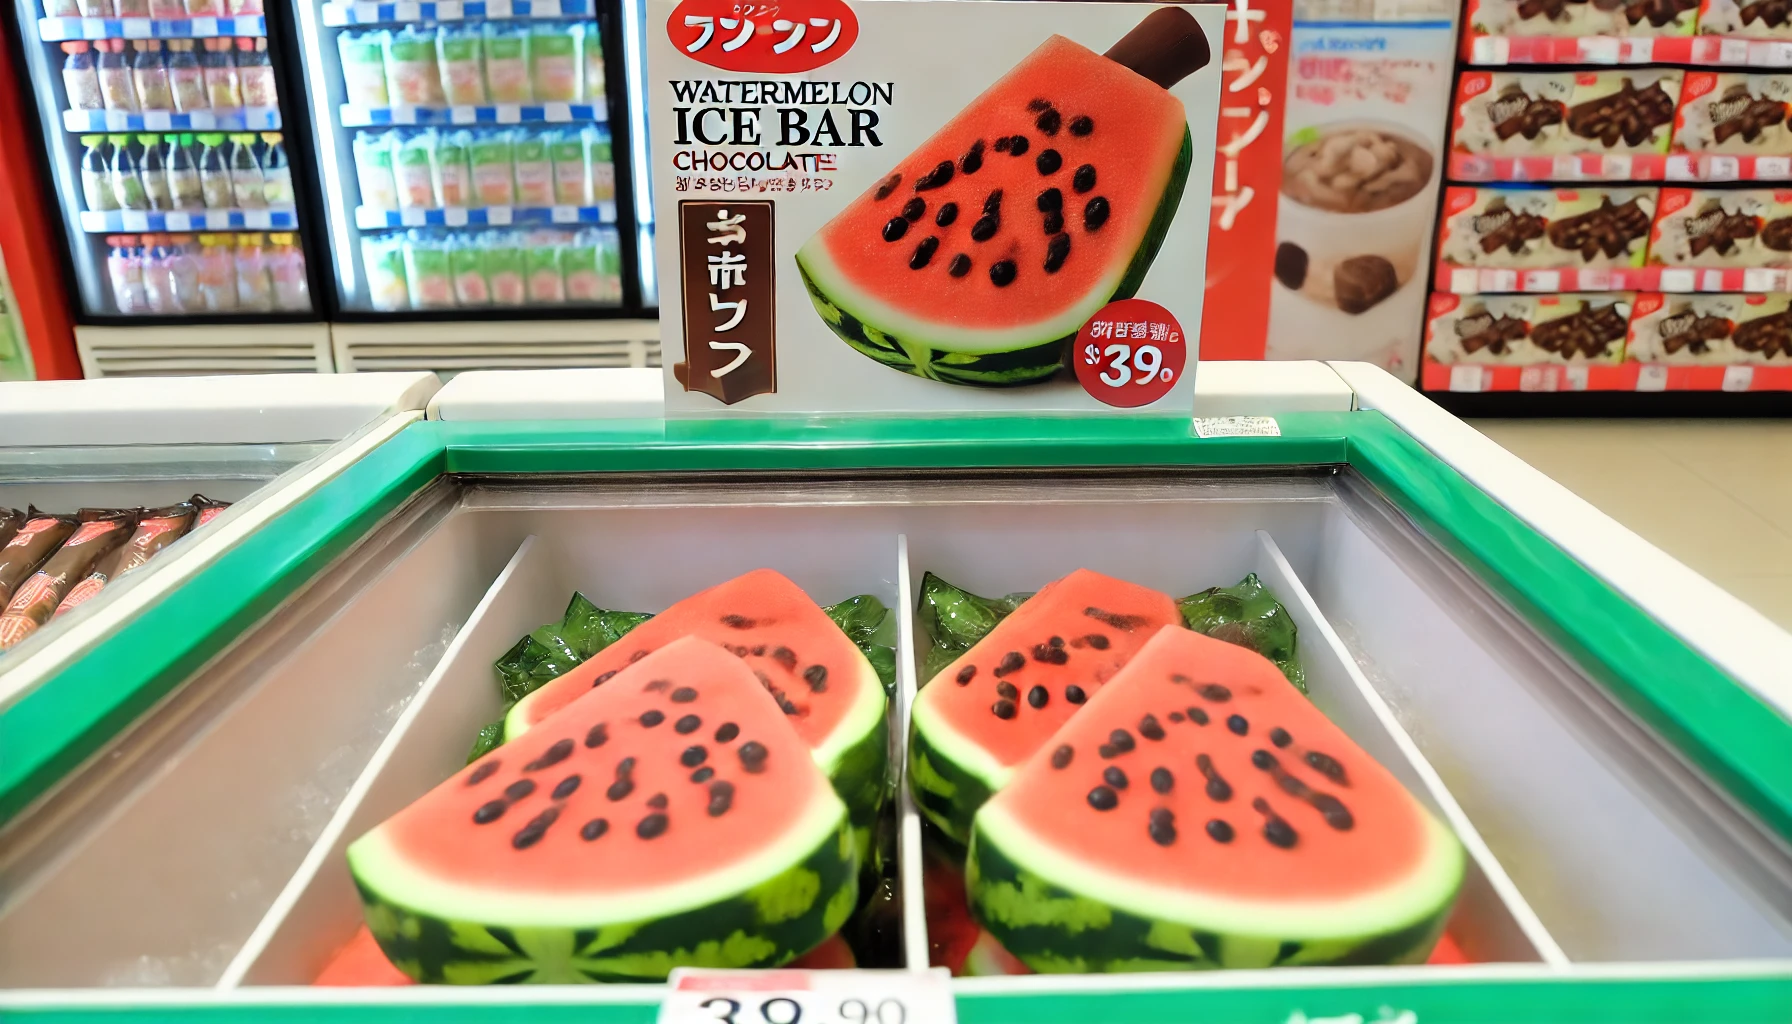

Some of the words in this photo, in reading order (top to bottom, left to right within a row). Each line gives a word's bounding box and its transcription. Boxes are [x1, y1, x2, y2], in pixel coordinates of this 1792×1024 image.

[668, 80, 895, 105] WATERMELON
[672, 107, 761, 146] ICE
[775, 107, 884, 146] BAR
[672, 151, 838, 172] CHOCOLATE
